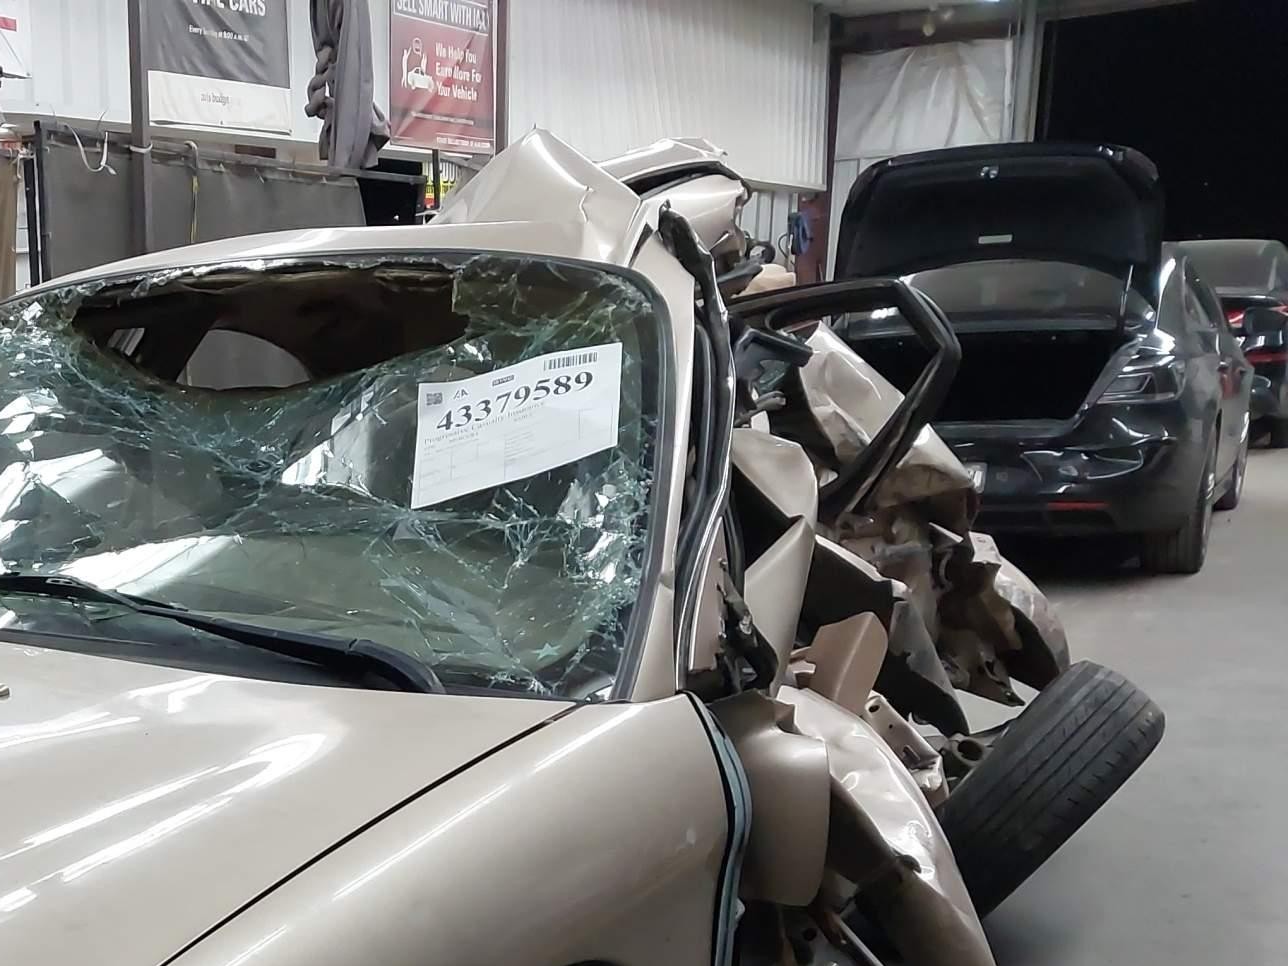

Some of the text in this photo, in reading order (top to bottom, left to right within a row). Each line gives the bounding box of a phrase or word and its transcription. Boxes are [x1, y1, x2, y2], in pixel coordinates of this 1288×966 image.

[229, 0, 266, 17] CARS
[397, 0, 417, 13] SELL
[418, 0, 449, 22] SMART
[450, 2, 472, 28] WITH
[435, 42, 448, 58] We
[448, 45, 464, 63] Help
[465, 49, 477, 64] You
[435, 62, 453, 78] Earn
[453, 65, 471, 81] More
[437, 83, 477, 101] Your Vehicle
[436, 371, 593, 431] 43379589
